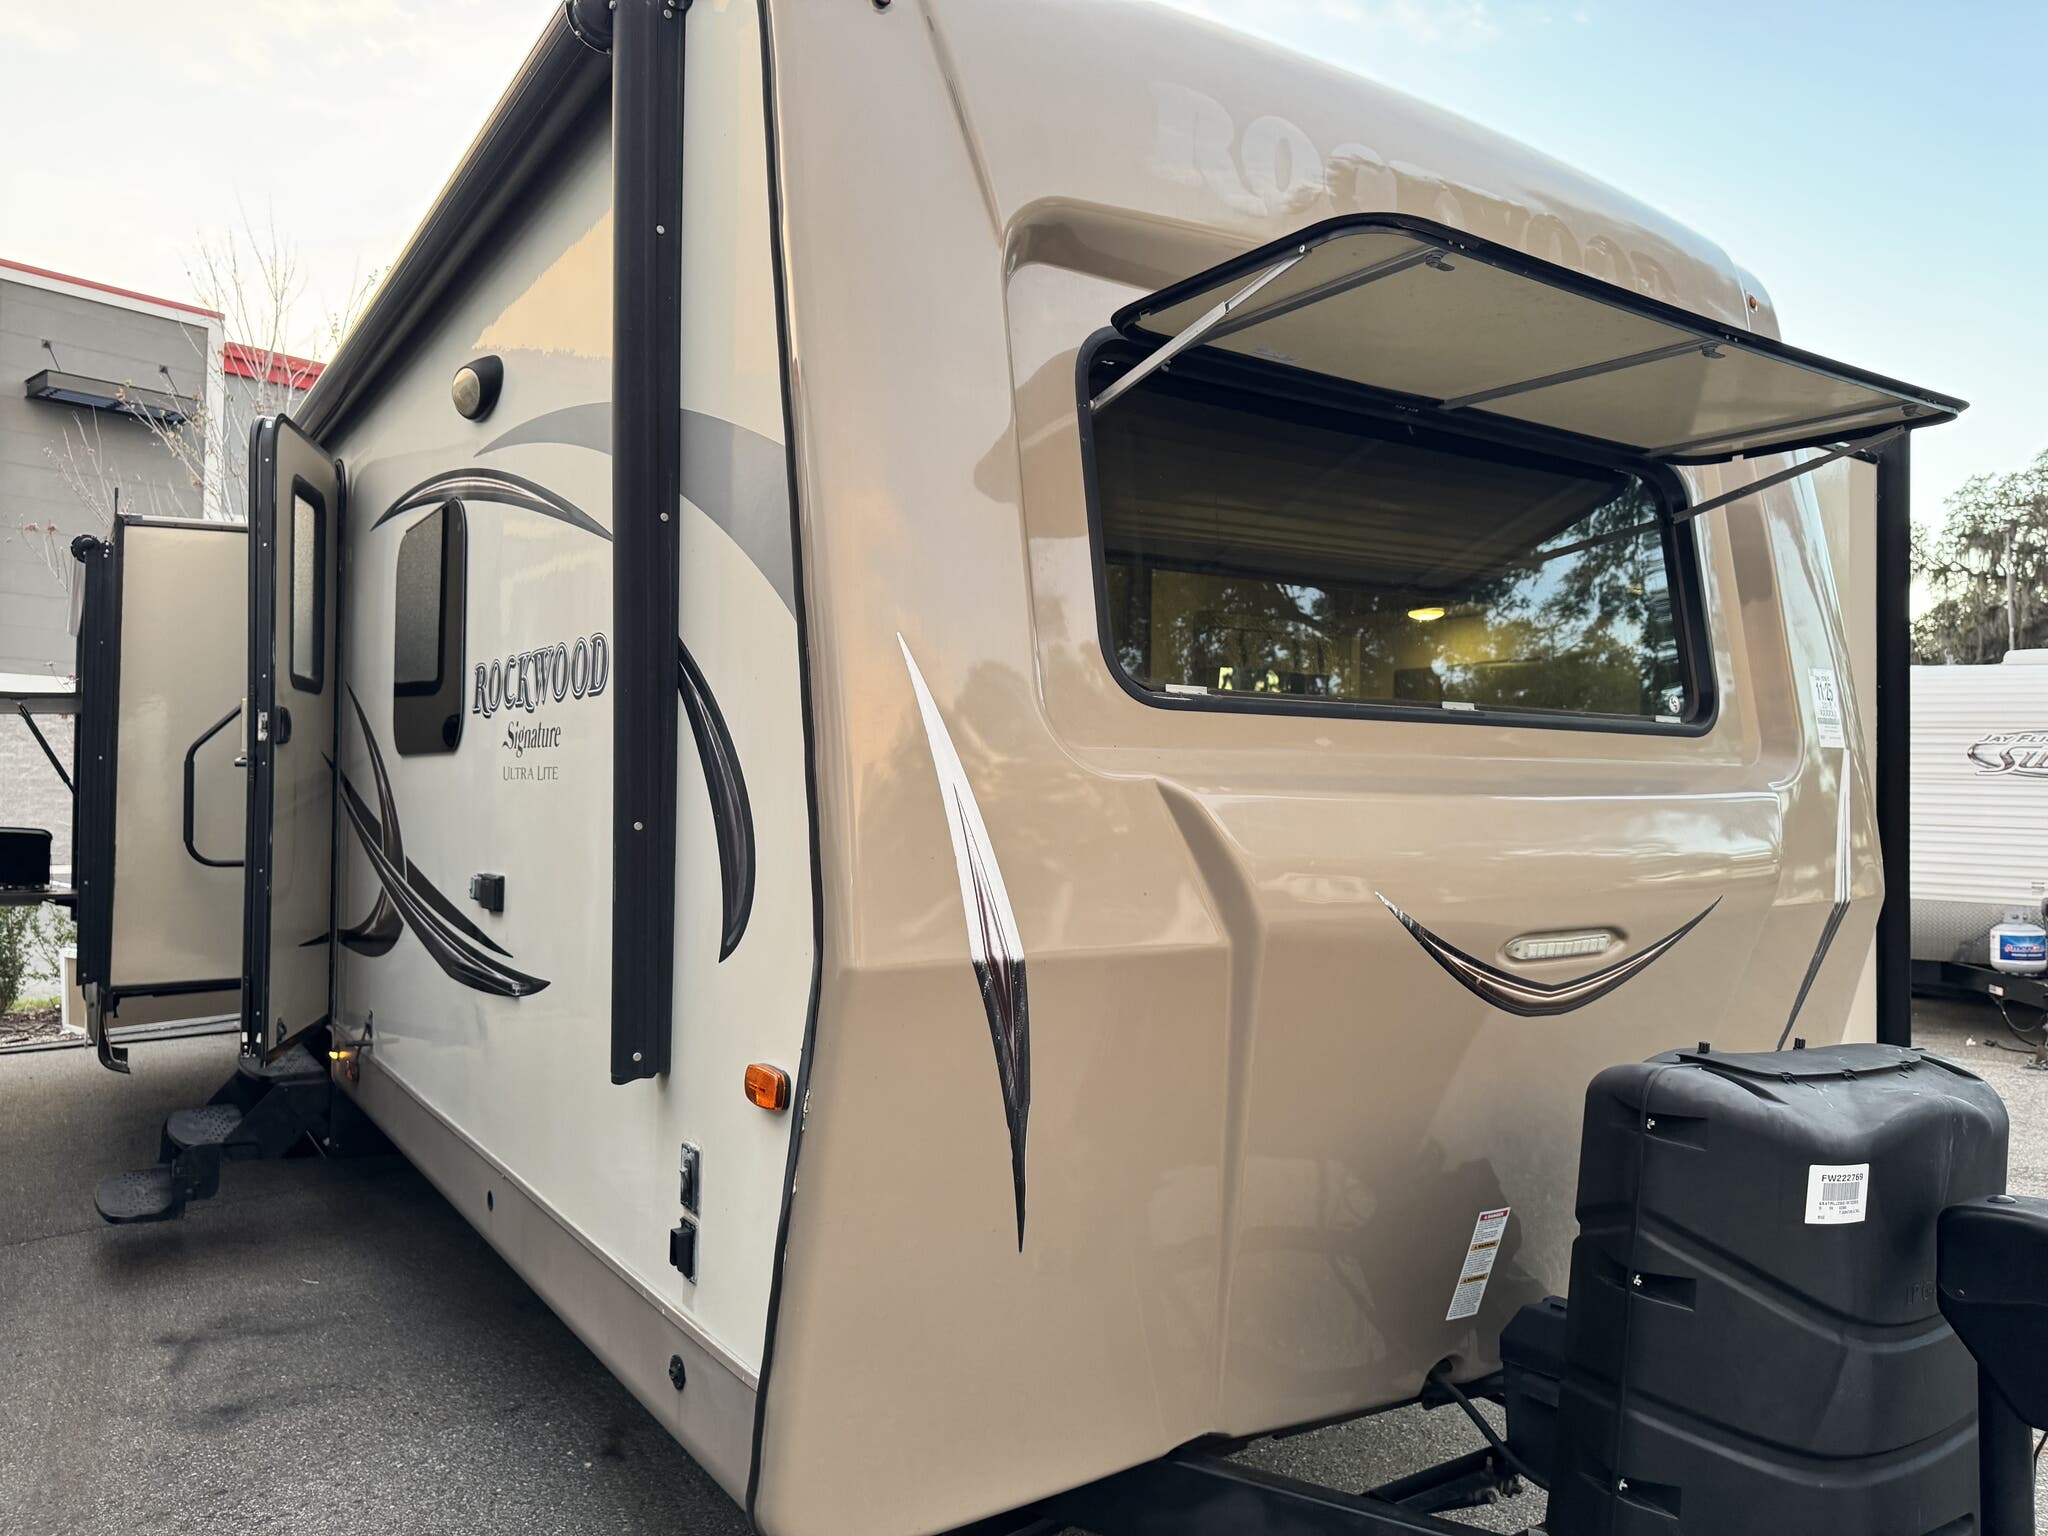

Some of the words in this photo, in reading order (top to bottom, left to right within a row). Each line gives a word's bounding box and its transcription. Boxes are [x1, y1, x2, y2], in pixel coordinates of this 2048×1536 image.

[473, 632, 610, 718] ROCKWOOD
[502, 721, 562, 758] Signature
[503, 766, 534, 781] ULTRA
[537, 765, 559, 781] LITE
[1821, 1173, 1864, 1182] FW222769
